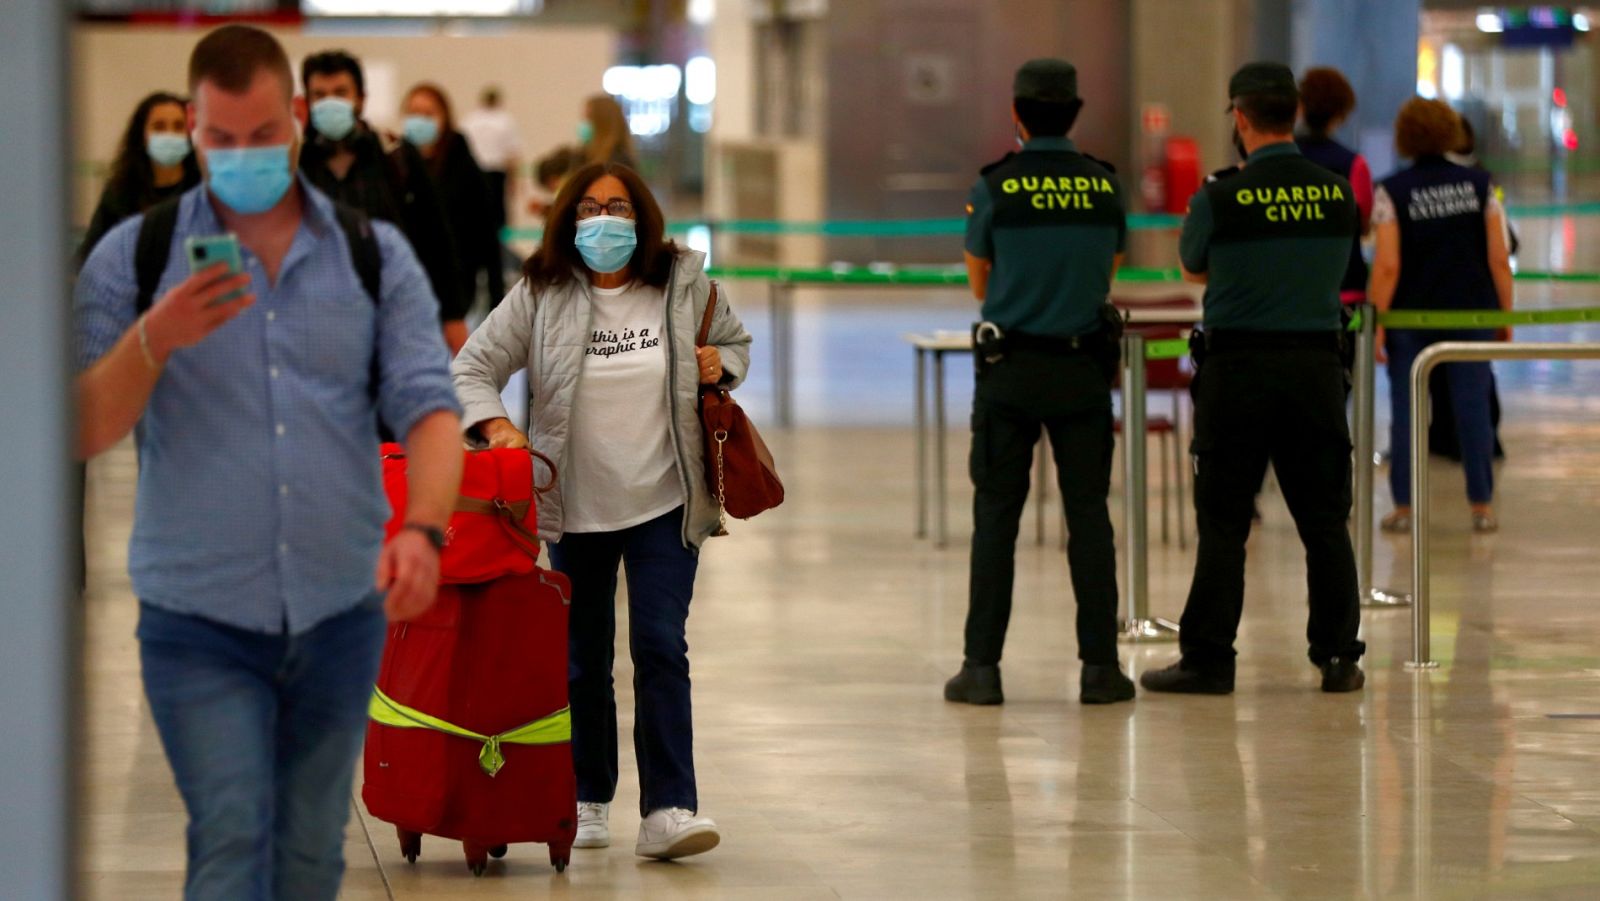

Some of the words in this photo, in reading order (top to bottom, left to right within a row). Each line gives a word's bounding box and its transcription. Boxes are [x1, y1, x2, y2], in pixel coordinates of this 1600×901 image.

[1002, 176, 1114, 193] GUARDIA
[1410, 182, 1475, 204] SANIDAD
[1031, 192, 1093, 209] CIVIL
[1236, 184, 1344, 205] GUARDIA
[1265, 203, 1325, 222] CIVIL
[1408, 198, 1480, 220] EXTERIOR
[592, 330, 618, 343] this
[622, 328, 635, 340] is
[639, 328, 649, 337] a
[640, 337, 659, 349] tee
